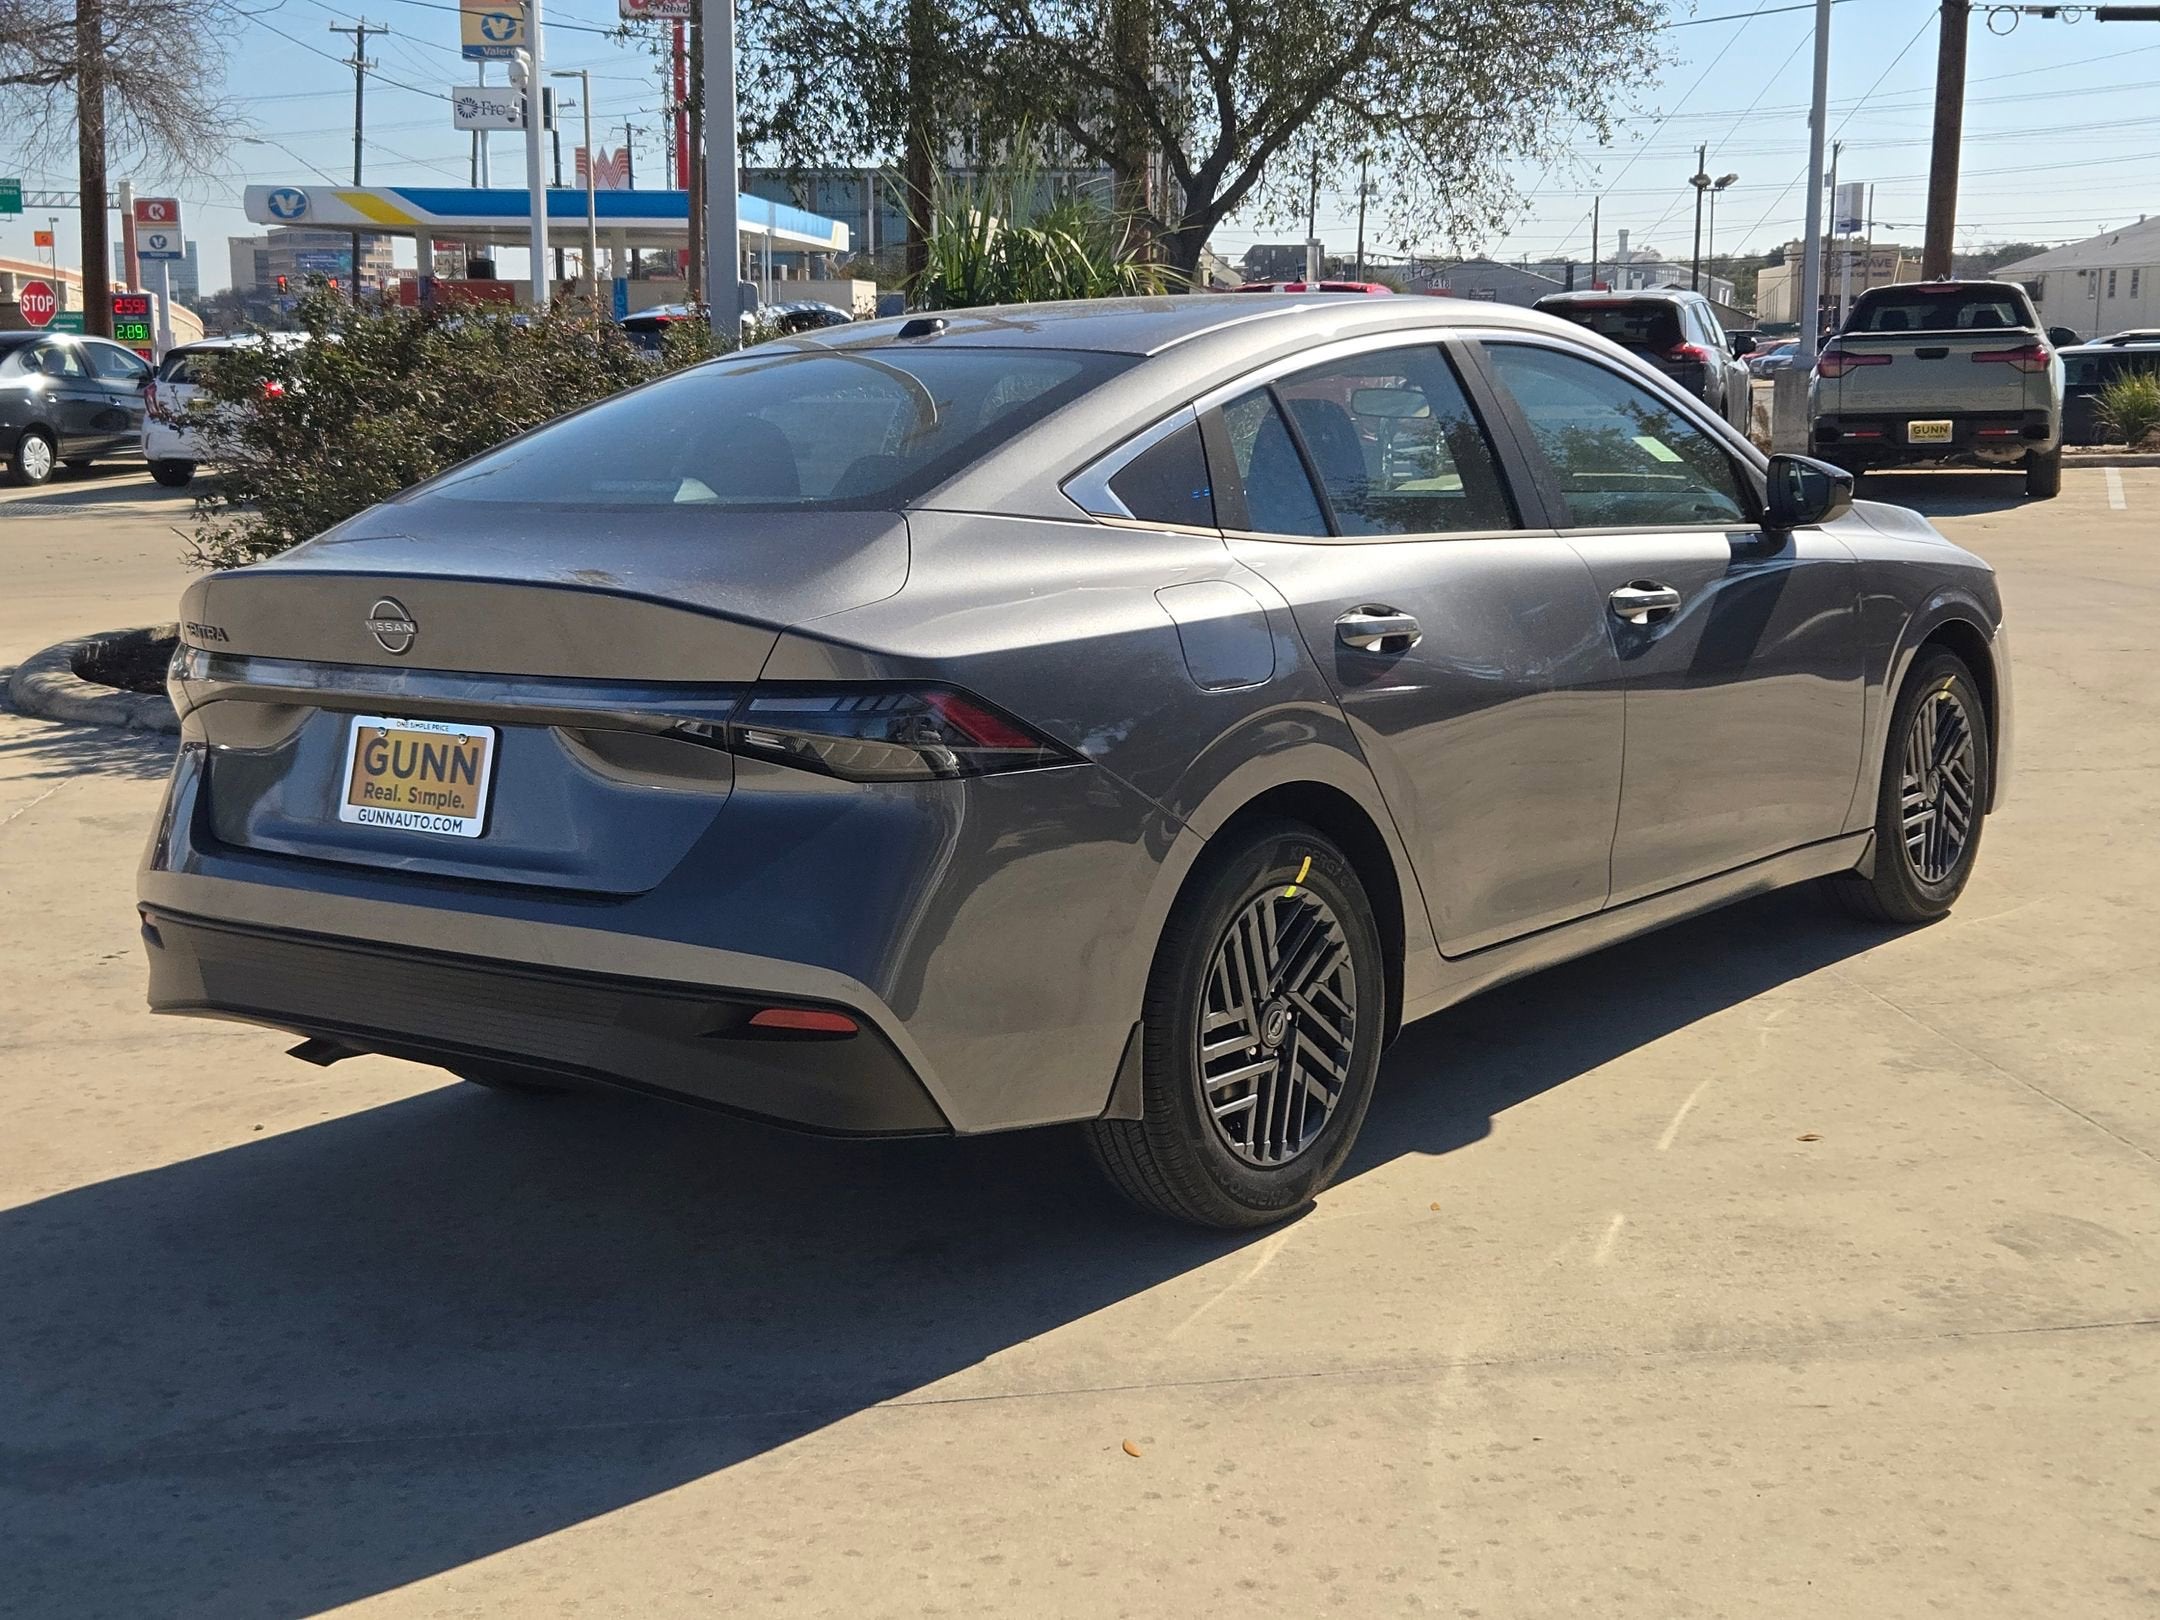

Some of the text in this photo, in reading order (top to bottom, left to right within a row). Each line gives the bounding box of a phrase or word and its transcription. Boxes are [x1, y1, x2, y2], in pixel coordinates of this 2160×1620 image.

[23, 294, 54, 312] STOP
[1913, 425, 1948, 434] GUNN
[365, 620, 414, 632] NISSAN
[431, 723, 449, 732] PRICE
[364, 738, 479, 785] GUNN
[364, 782, 401, 802] Real.
[358, 808, 463, 833] GUNNAUTO.COM
